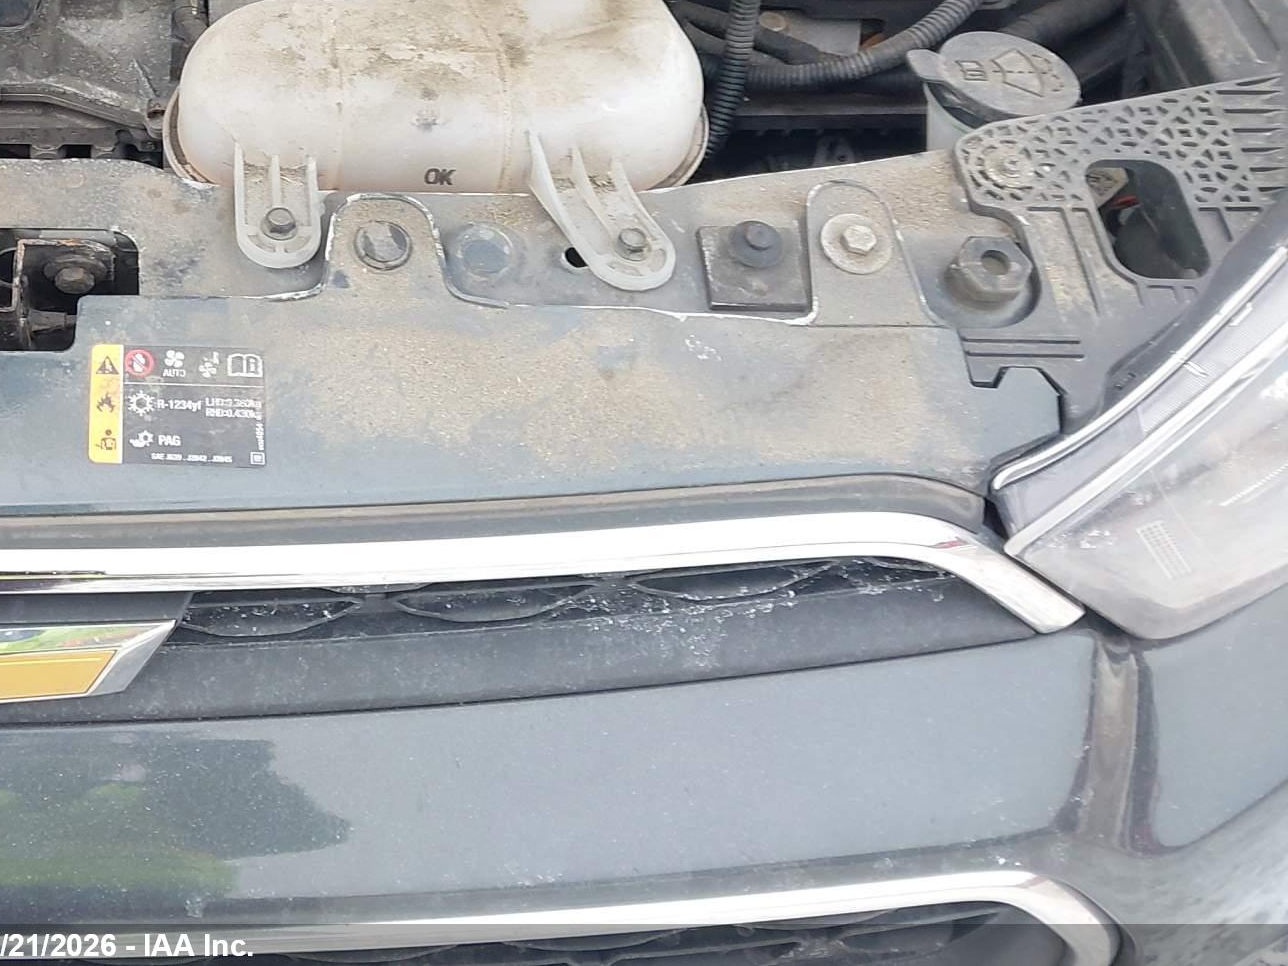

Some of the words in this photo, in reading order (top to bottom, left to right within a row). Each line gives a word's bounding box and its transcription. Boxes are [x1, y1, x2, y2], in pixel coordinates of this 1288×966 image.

[424, 168, 456, 185] OK
[157, 399, 202, 411] R-1234yf
[158, 434, 181, 446] PAG
